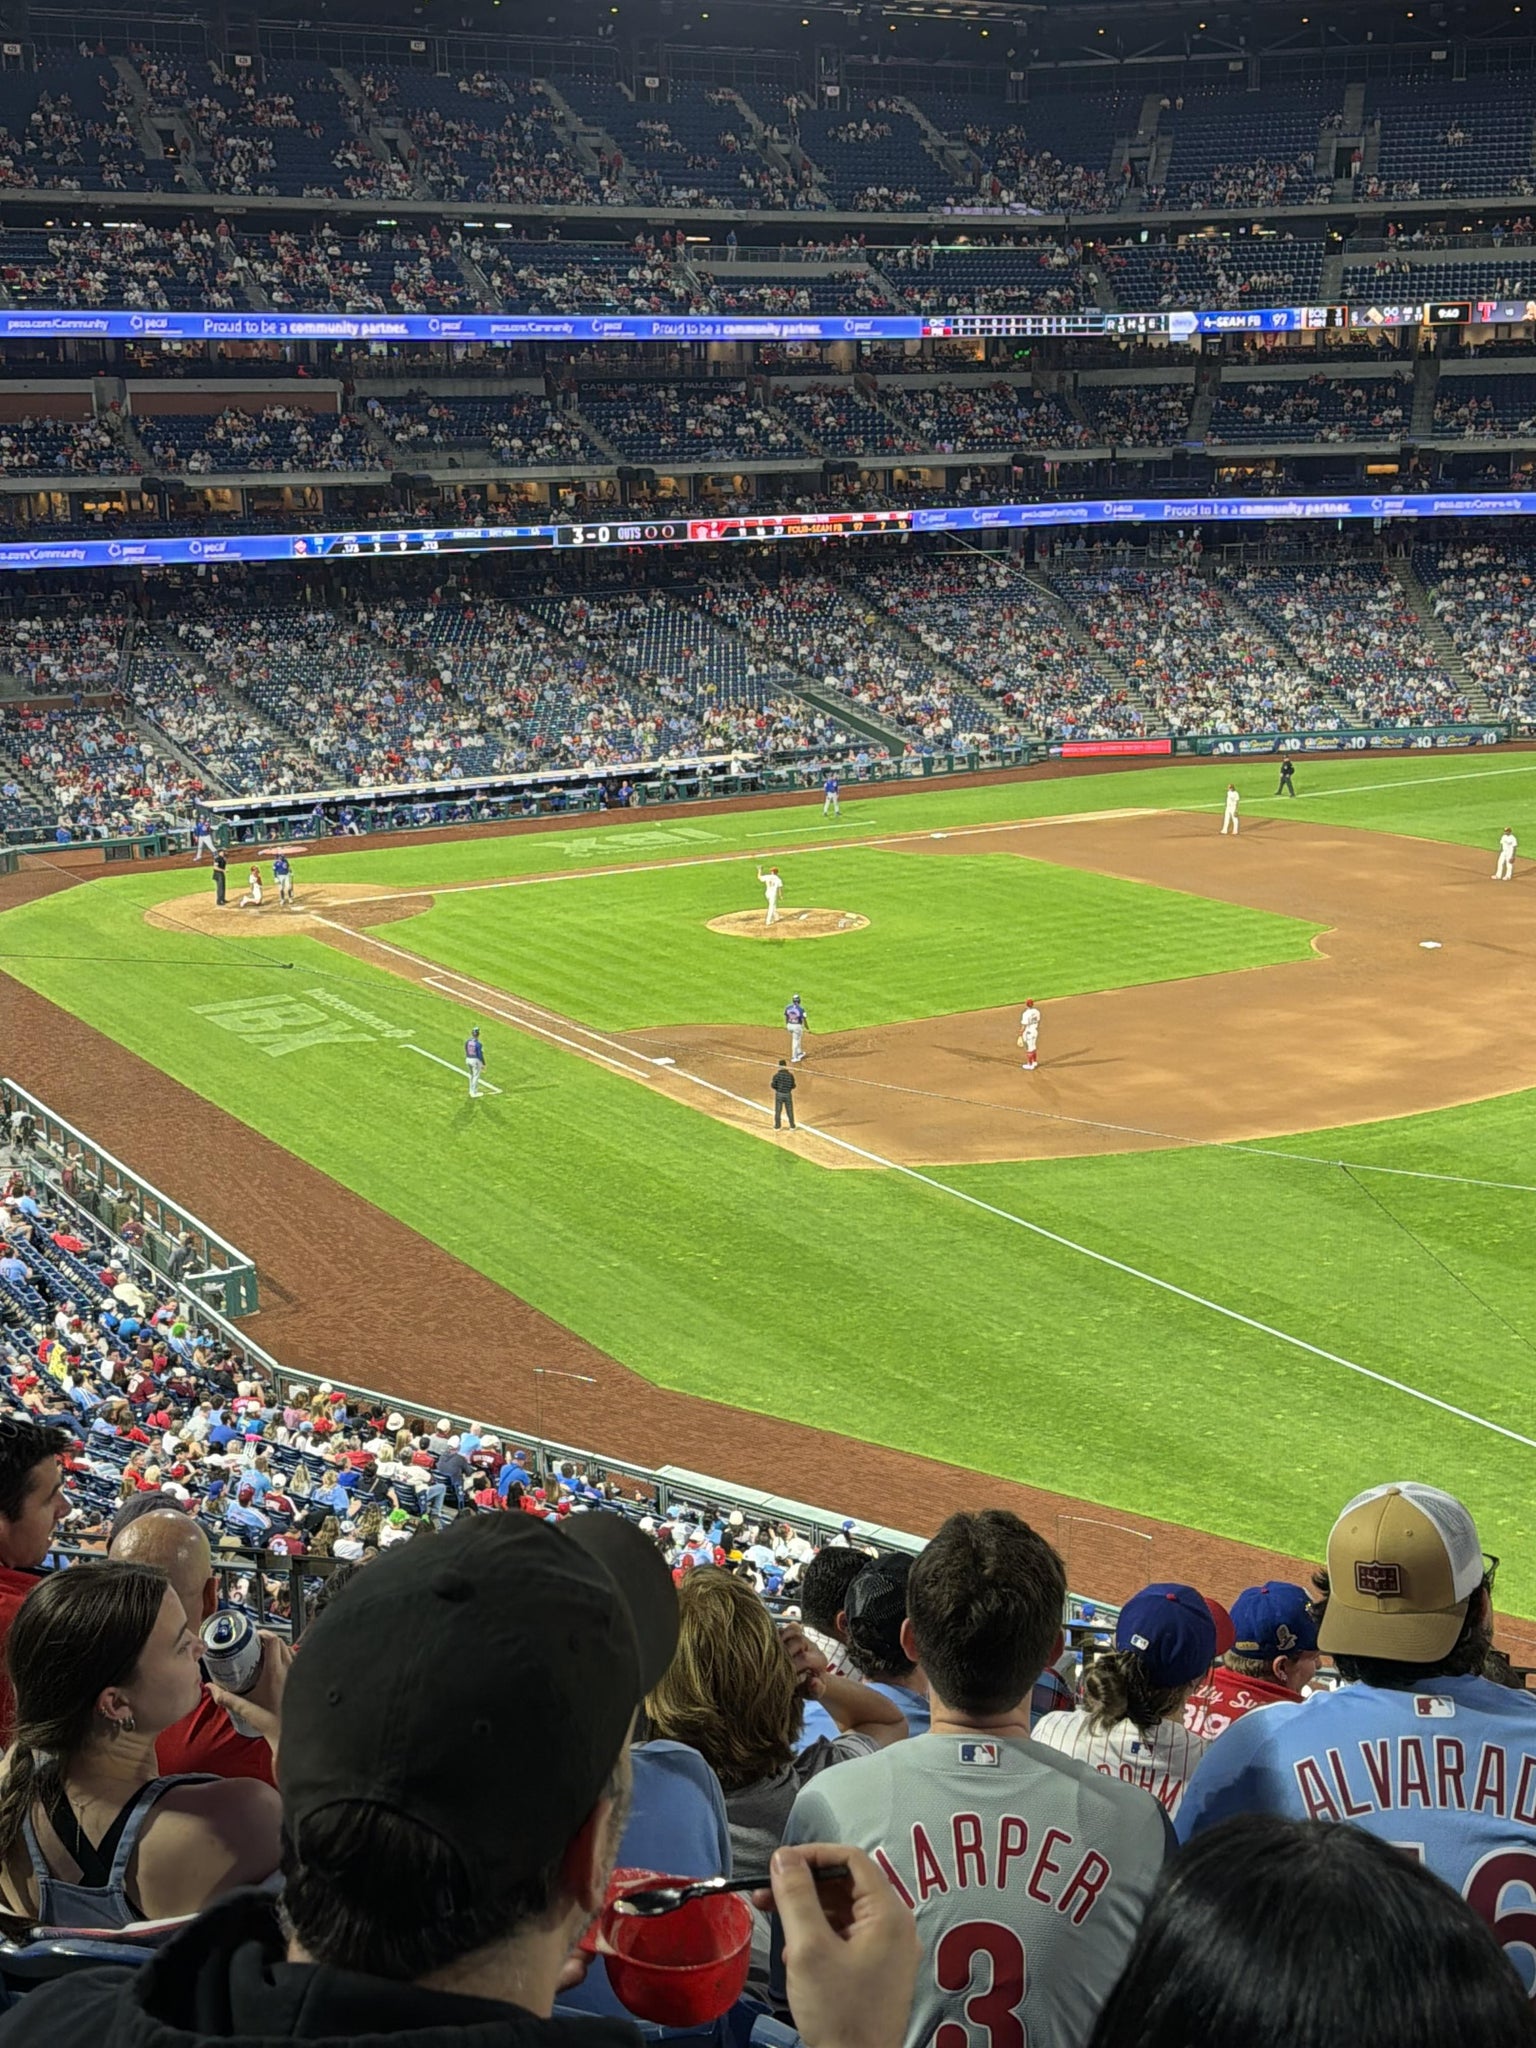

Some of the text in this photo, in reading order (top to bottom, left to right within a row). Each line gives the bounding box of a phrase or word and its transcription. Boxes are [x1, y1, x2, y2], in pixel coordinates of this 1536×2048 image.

[204, 318, 242, 333] Proud
[244, 319, 259, 333] to
[260, 319, 276, 333] be
[289, 319, 359, 335] community
[361, 321, 409, 335] partner.
[652, 320, 685, 334] Proud
[686, 320, 698, 334] to
[722, 321, 780, 336] community
[1164, 504, 1198, 517] Proud
[1199, 504, 1212, 516] to
[1239, 501, 1303, 516] community
[617, 526, 641, 540] OUTS
[1350, 736, 1367, 749] 10
[1416, 735, 1432, 748] 10
[1482, 733, 1497, 745] 10
[1217, 741, 1235, 754] 10
[935, 1919, 1026, 2048] 3
